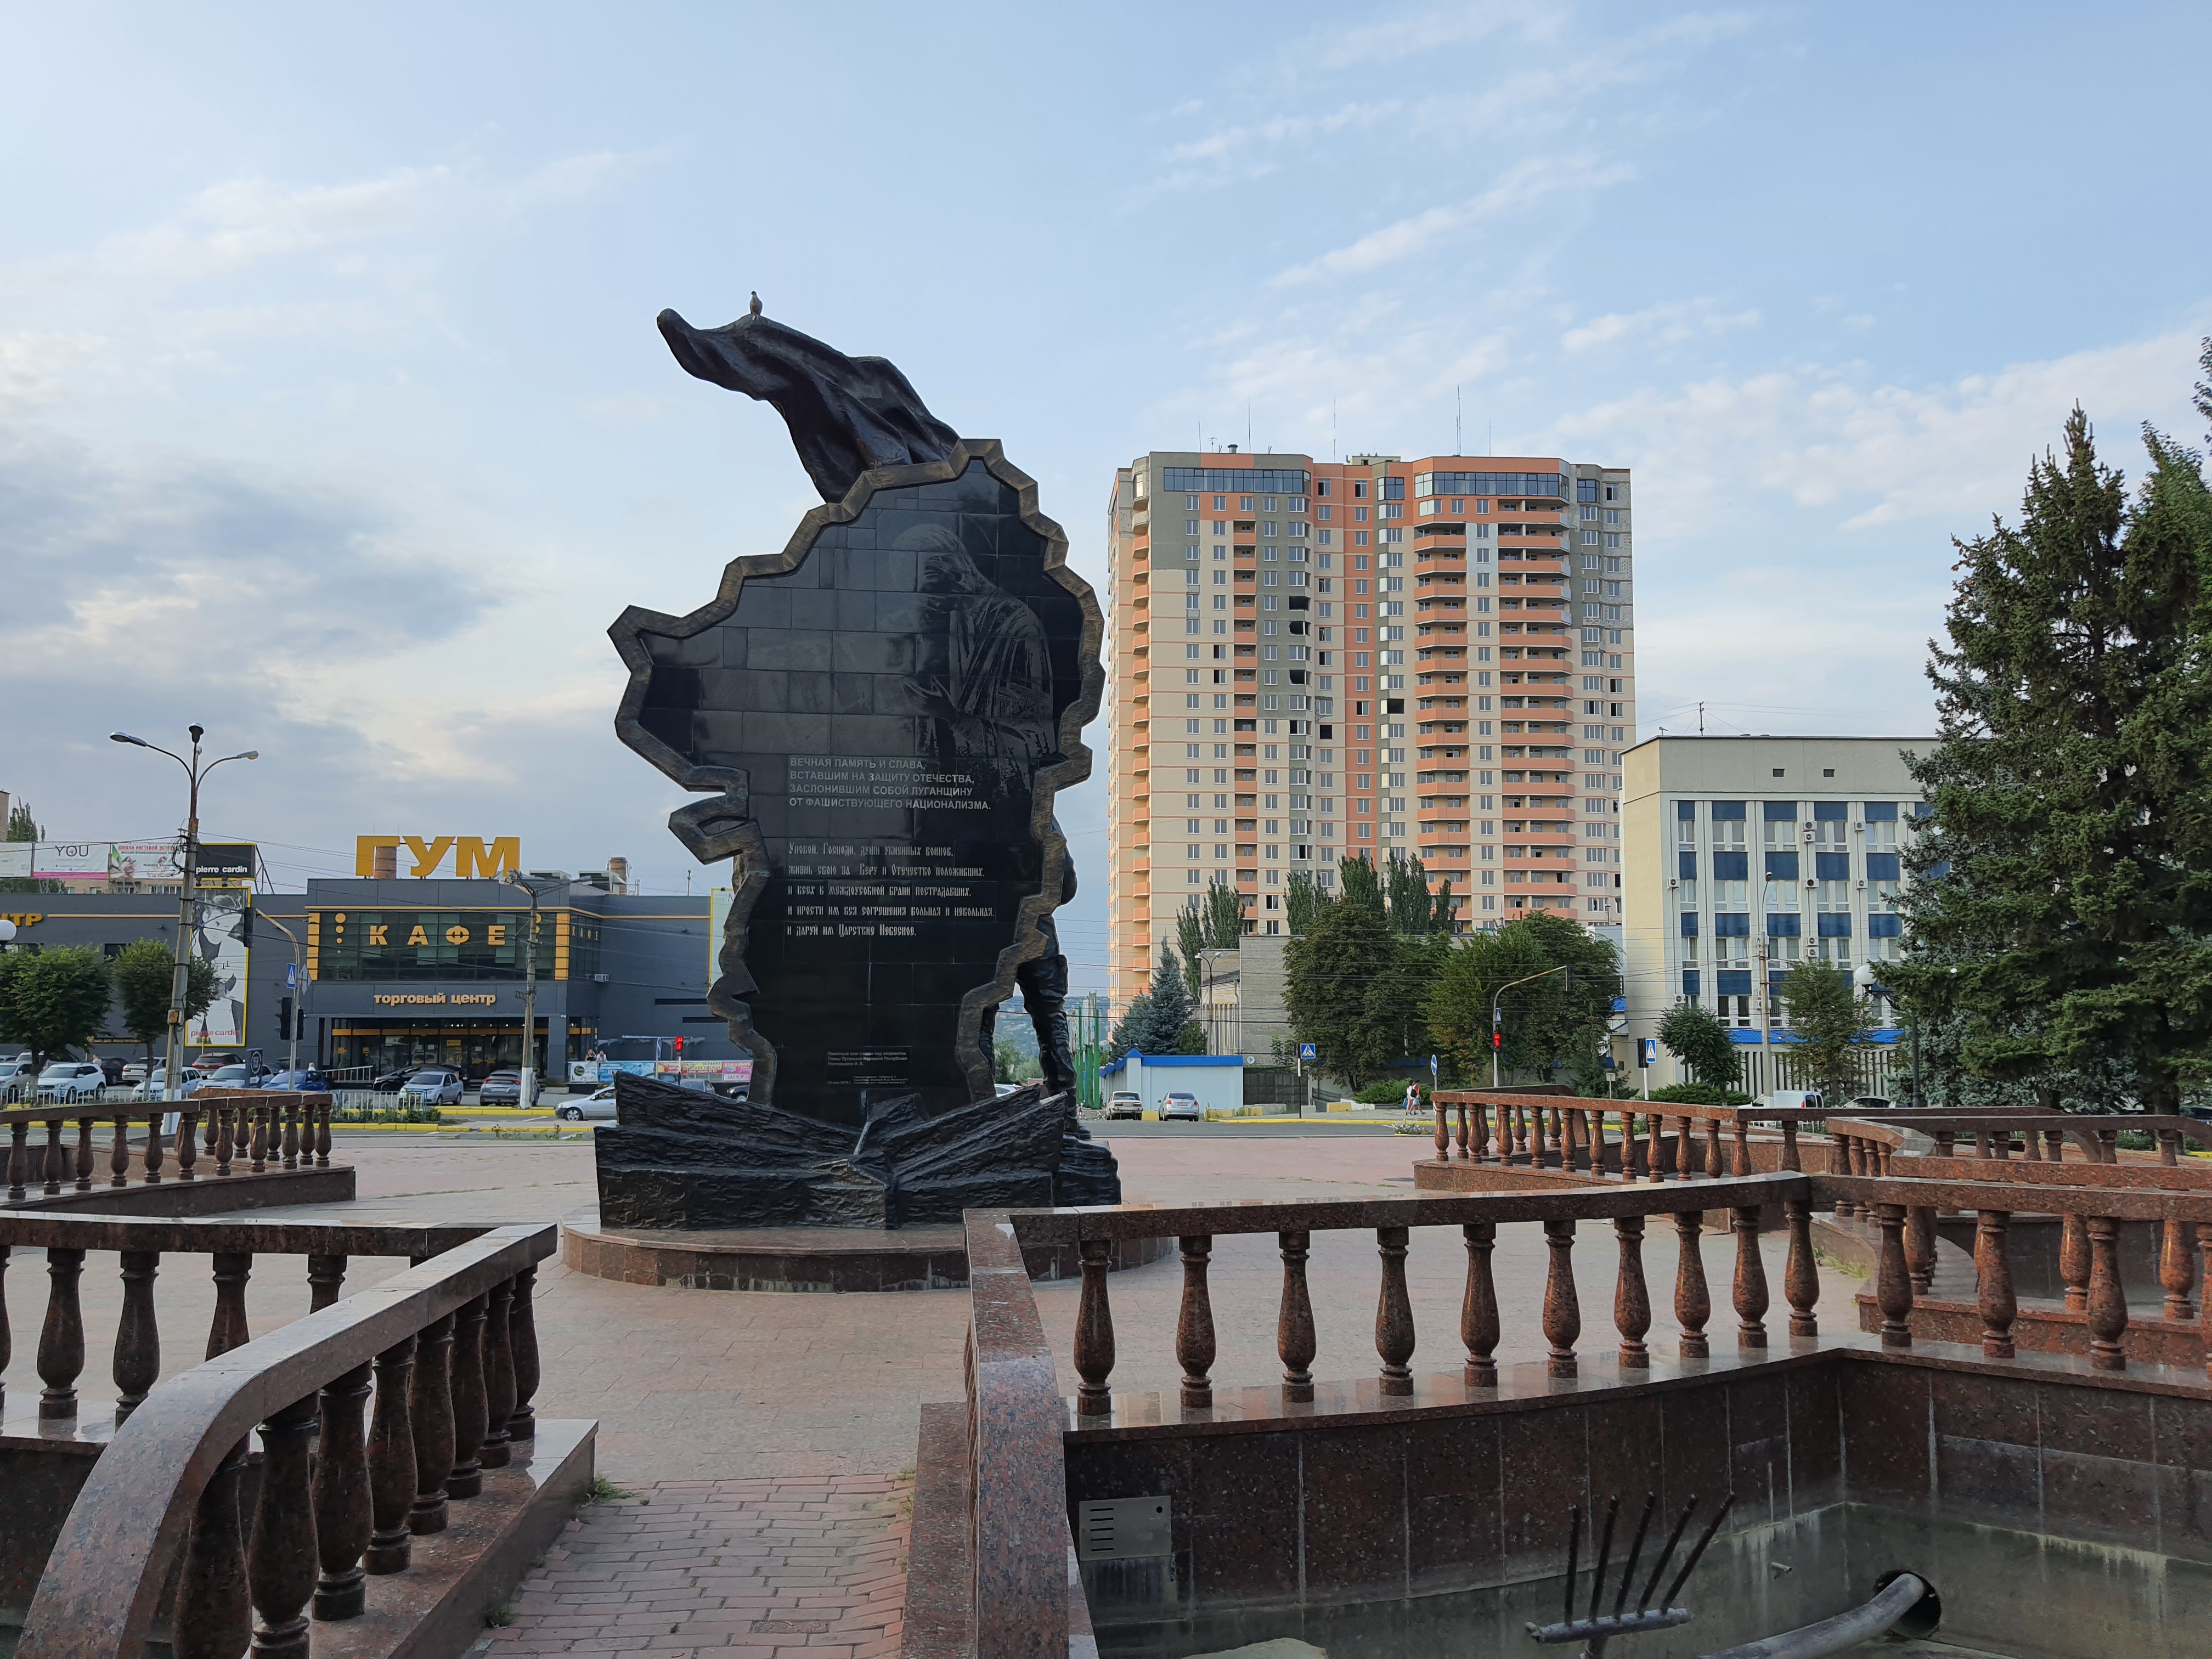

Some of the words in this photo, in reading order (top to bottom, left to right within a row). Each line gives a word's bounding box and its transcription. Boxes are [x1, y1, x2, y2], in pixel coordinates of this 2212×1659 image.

[790, 757, 832, 767] ВЕЧНАЯ
[834, 759, 876, 768] ПАМЯТЬ
[879, 760, 886, 768] И
[889, 760, 926, 770] СЛАВА,
[790, 770, 848, 780] ВСТАВШИМ
[852, 772, 865, 781] НА
[868, 772, 910, 783] ЗАЩИТУ
[912, 774, 974, 784] ОТЕЧЕСТВА,
[789, 784, 870, 794] ЗАСЛОНИВШИМ
[873, 785, 909, 795] СОБОЙ
[911, 787, 973, 797] ЛУГАНЩИНУ
[789, 798, 803, 806] ОТ
[806, 798, 902, 809] ФАШИСТВУЮЩЕГО
[906, 800, 991, 810] НАЦИОНАЛИЗМА.
[55, 845, 89, 857] YOU
[356, 835, 521, 878] ГУМ
[860, 845, 880, 857] души
[884, 847, 922, 856] убиенных
[196, 865, 219, 874] pierre
[788, 865, 813, 875] жизнь
[817, 865, 837, 875] свою
[842, 866, 850, 875] за
[860, 863, 878, 876] Веру
[882, 866, 887, 876] и
[891, 864, 932, 876] Отечество
[788, 885, 792, 895] и
[797, 885, 815, 895] всех
[820, 885, 824, 895] в
[829, 884, 885, 897] междоусобной
[889, 887, 911, 896] брани
[788, 906, 792, 915] и
[797, 906, 823, 916] прости
[828, 906, 839, 916] им
[844, 906, 857, 916] вся
[862, 906, 906, 916] согрешения
[911, 906, 941, 916] вольная
[945, 907, 950, 916] и
[0, 913, 43, 927] ТР
[369, 926, 506, 945] КАФЕ
[787, 926, 792, 935] и
[796, 924, 819, 936] даруй
[823, 926, 834, 935] им
[839, 923, 875, 938] Царствие
[879, 923, 917, 936] Небесное.
[374, 992, 446, 1007] торговый
[451, 994, 496, 1006] центр
